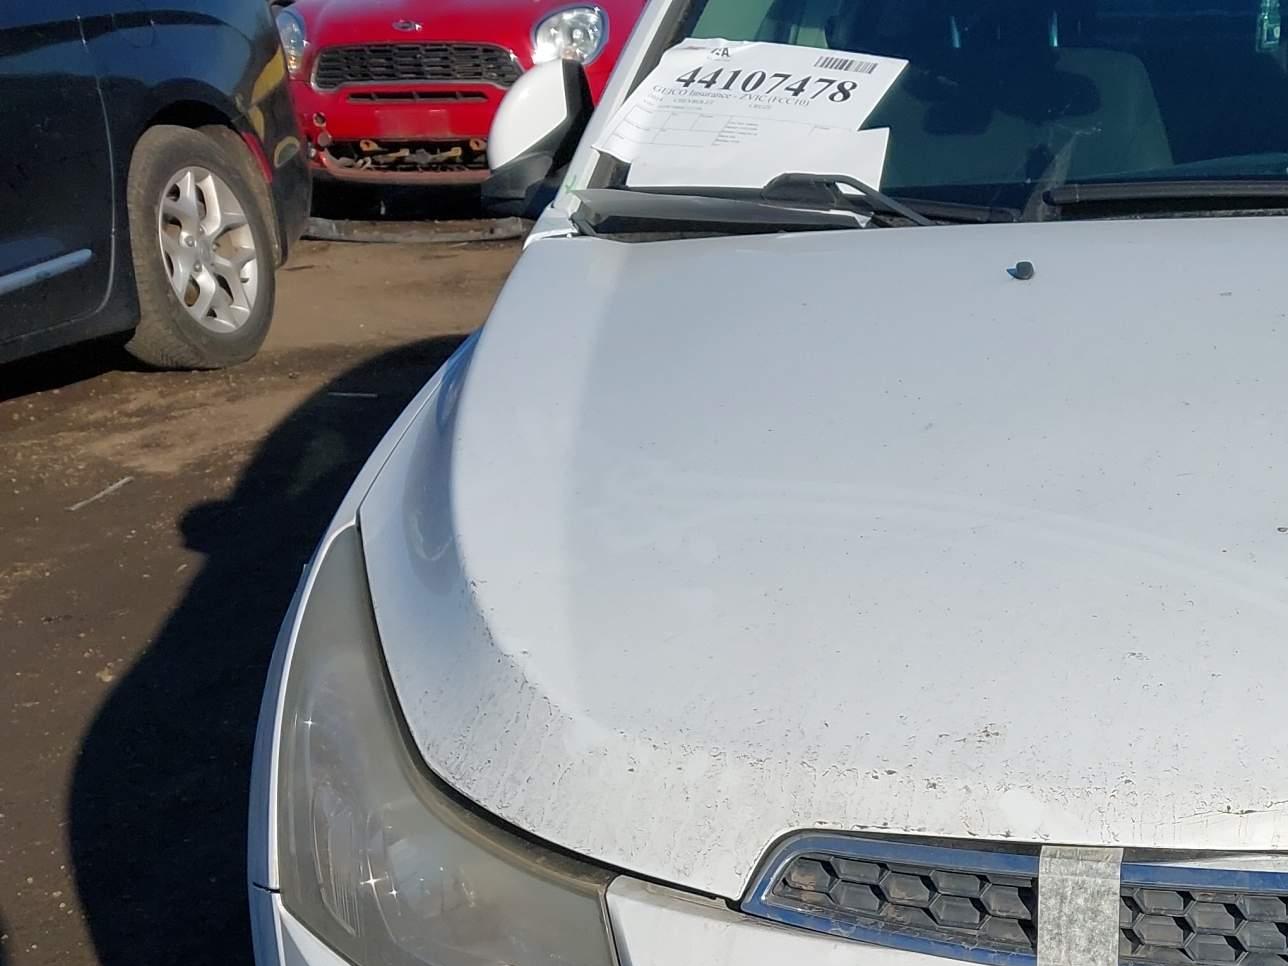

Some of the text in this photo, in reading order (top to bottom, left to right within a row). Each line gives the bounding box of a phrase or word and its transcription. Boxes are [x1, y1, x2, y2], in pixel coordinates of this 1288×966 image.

[652, 84, 689, 97] GEICO
[687, 88, 732, 99] Insurance
[676, 66, 859, 103] 44107478
